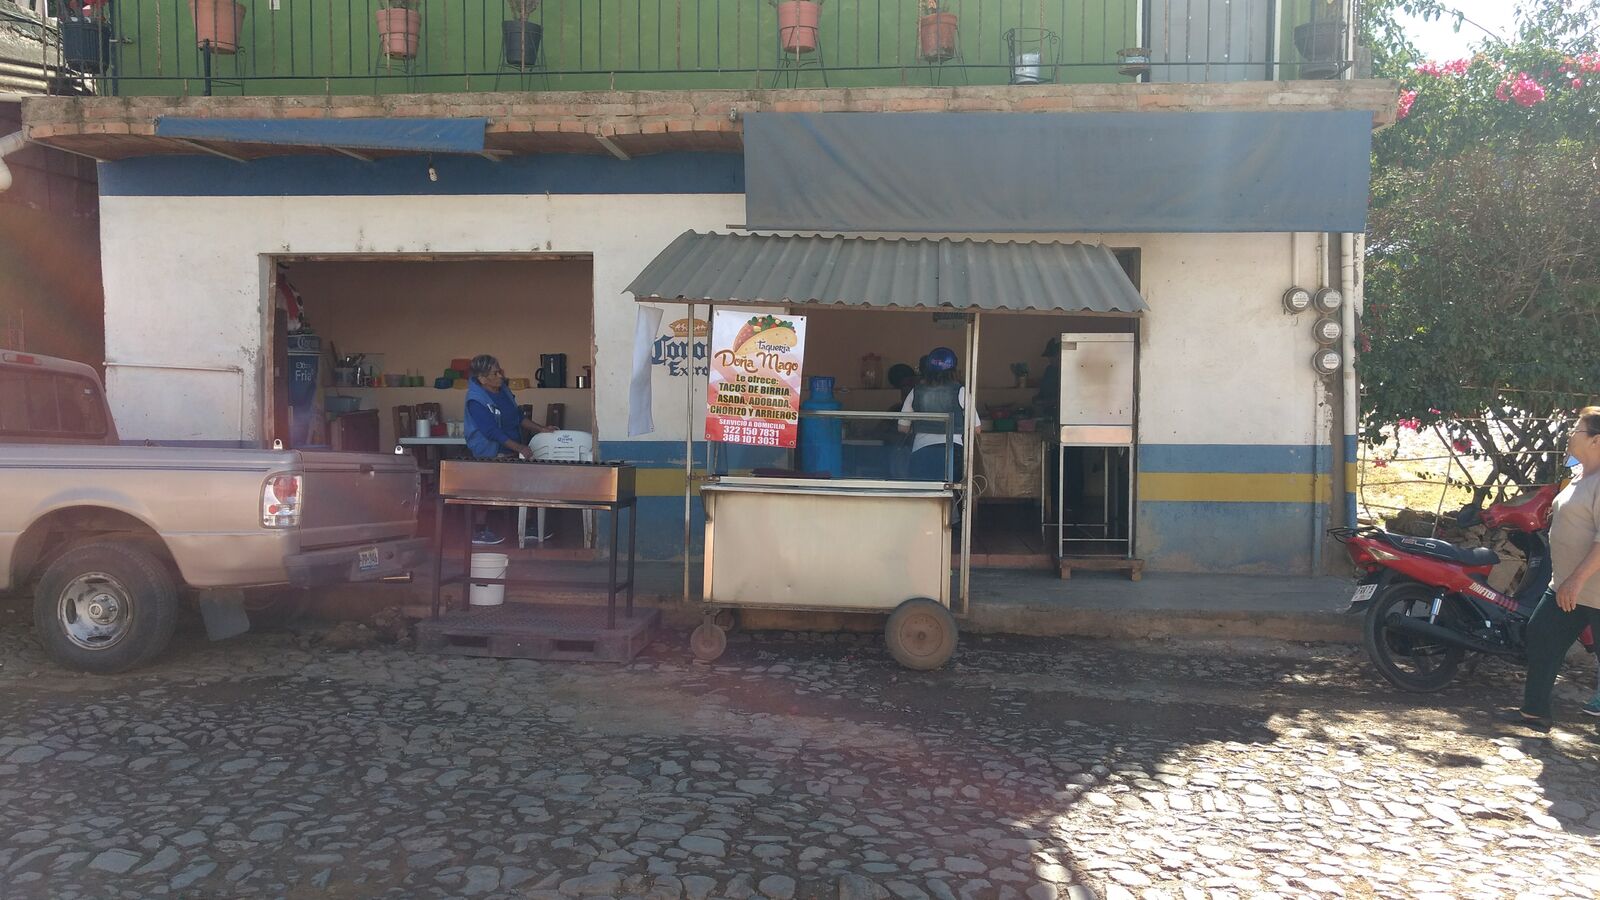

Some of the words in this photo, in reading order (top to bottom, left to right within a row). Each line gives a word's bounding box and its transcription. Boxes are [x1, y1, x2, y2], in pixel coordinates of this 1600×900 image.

[714, 349, 758, 373] Doña
[756, 352, 798, 375] Mago
[736, 374, 746, 383] Le
[747, 375, 779, 385] ofrece:
[719, 382, 746, 393] TACOS
[748, 384, 759, 393] DE
[710, 405, 747, 416] CHORIZO
[748, 407, 754, 416] Y
[755, 409, 797, 420] ARRIEROS
[719, 418, 748, 426] SERVICIO
[753, 421, 785, 430] DOMICILIO
[723, 425, 740, 434] 322
[742, 427, 758, 436] 150
[759, 428, 780, 437] 7831
[722, 433, 740, 442] 388
[742, 435, 756, 444] 101
[757, 437, 779, 446] 3031
[1469, 581, 1497, 601] DRIFTER
